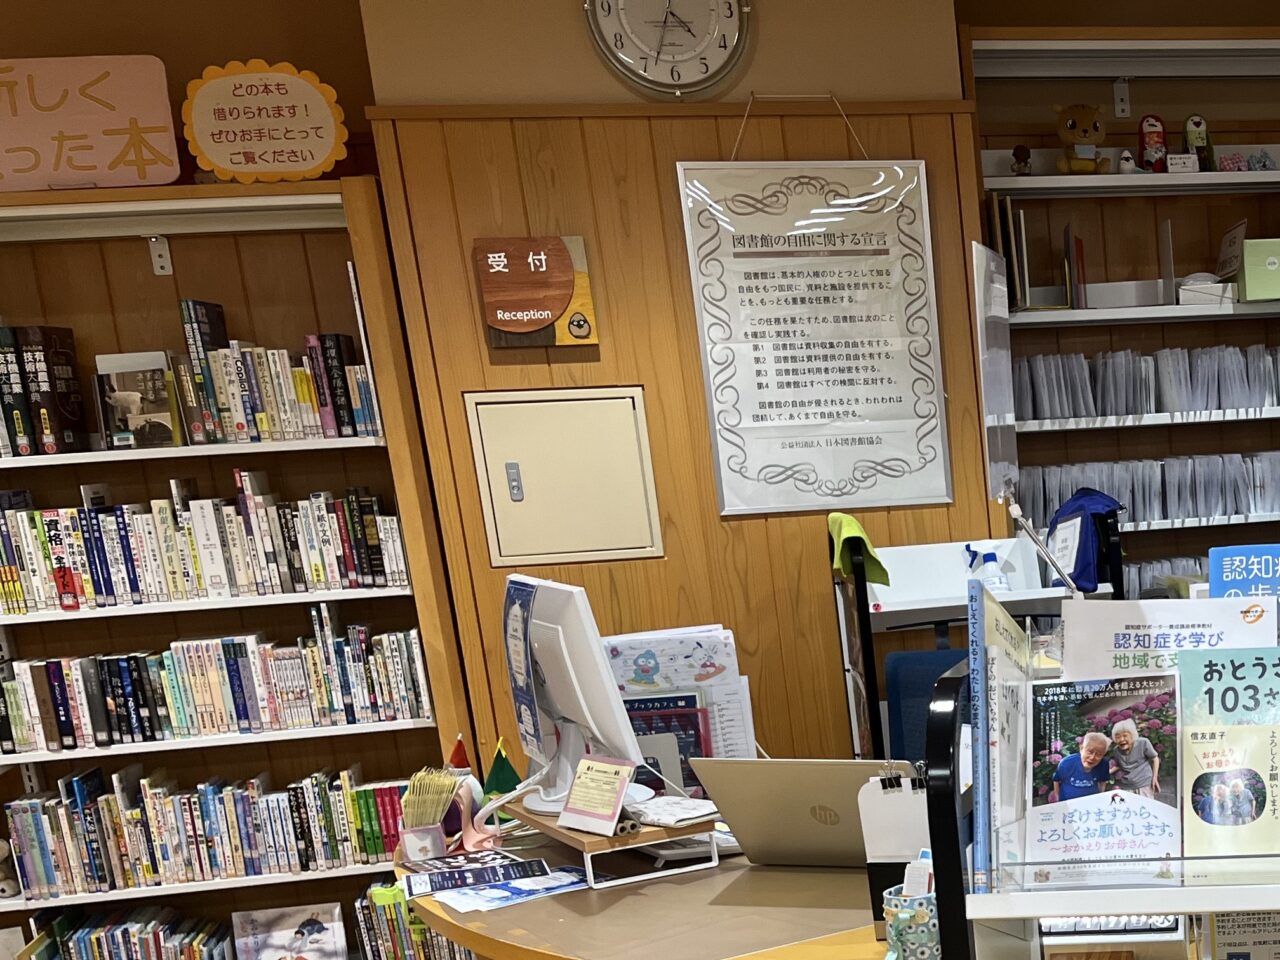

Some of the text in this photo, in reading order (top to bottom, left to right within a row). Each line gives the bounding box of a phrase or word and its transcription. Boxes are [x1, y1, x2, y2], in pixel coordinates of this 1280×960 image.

[601, 0, 612, 17] 9
[724, 1, 734, 19] 3
[614, 32, 624, 50] 8
[718, 34, 728, 50] 4
[639, 57, 648, 73] 7
[670, 64, 681, 82] 6
[700, 57, 709, 75] 5
[231, 81, 289, 97] どの本も
[212, 103, 310, 122] 借りられます！
[209, 125, 325, 143] ぜひお手にとって
[0, 117, 174, 180] った本
[228, 149, 314, 166] ご覧ください
[731, 231, 888, 249] 図書館の自由に関する宣言
[496, 309, 552, 322] Reception
[234, 360, 248, 397] Copilot
[44, 519, 67, 546] 資格
[314, 504, 331, 547] 手紙の文例
[1113, 631, 1225, 649] 認知症を学び
[970, 668, 980, 730] わたしのなまえ
[1190, 731, 1226, 741] 信友直子
[1202, 748, 1235, 760] おかえり
[1205, 757, 1241, 769] お母さん
[1268, 730, 1279, 820] よろしくお願いします。
[1062, 806, 1158, 824] ぼけますから、
[1036, 822, 1174, 843] よろしくお願いします。
